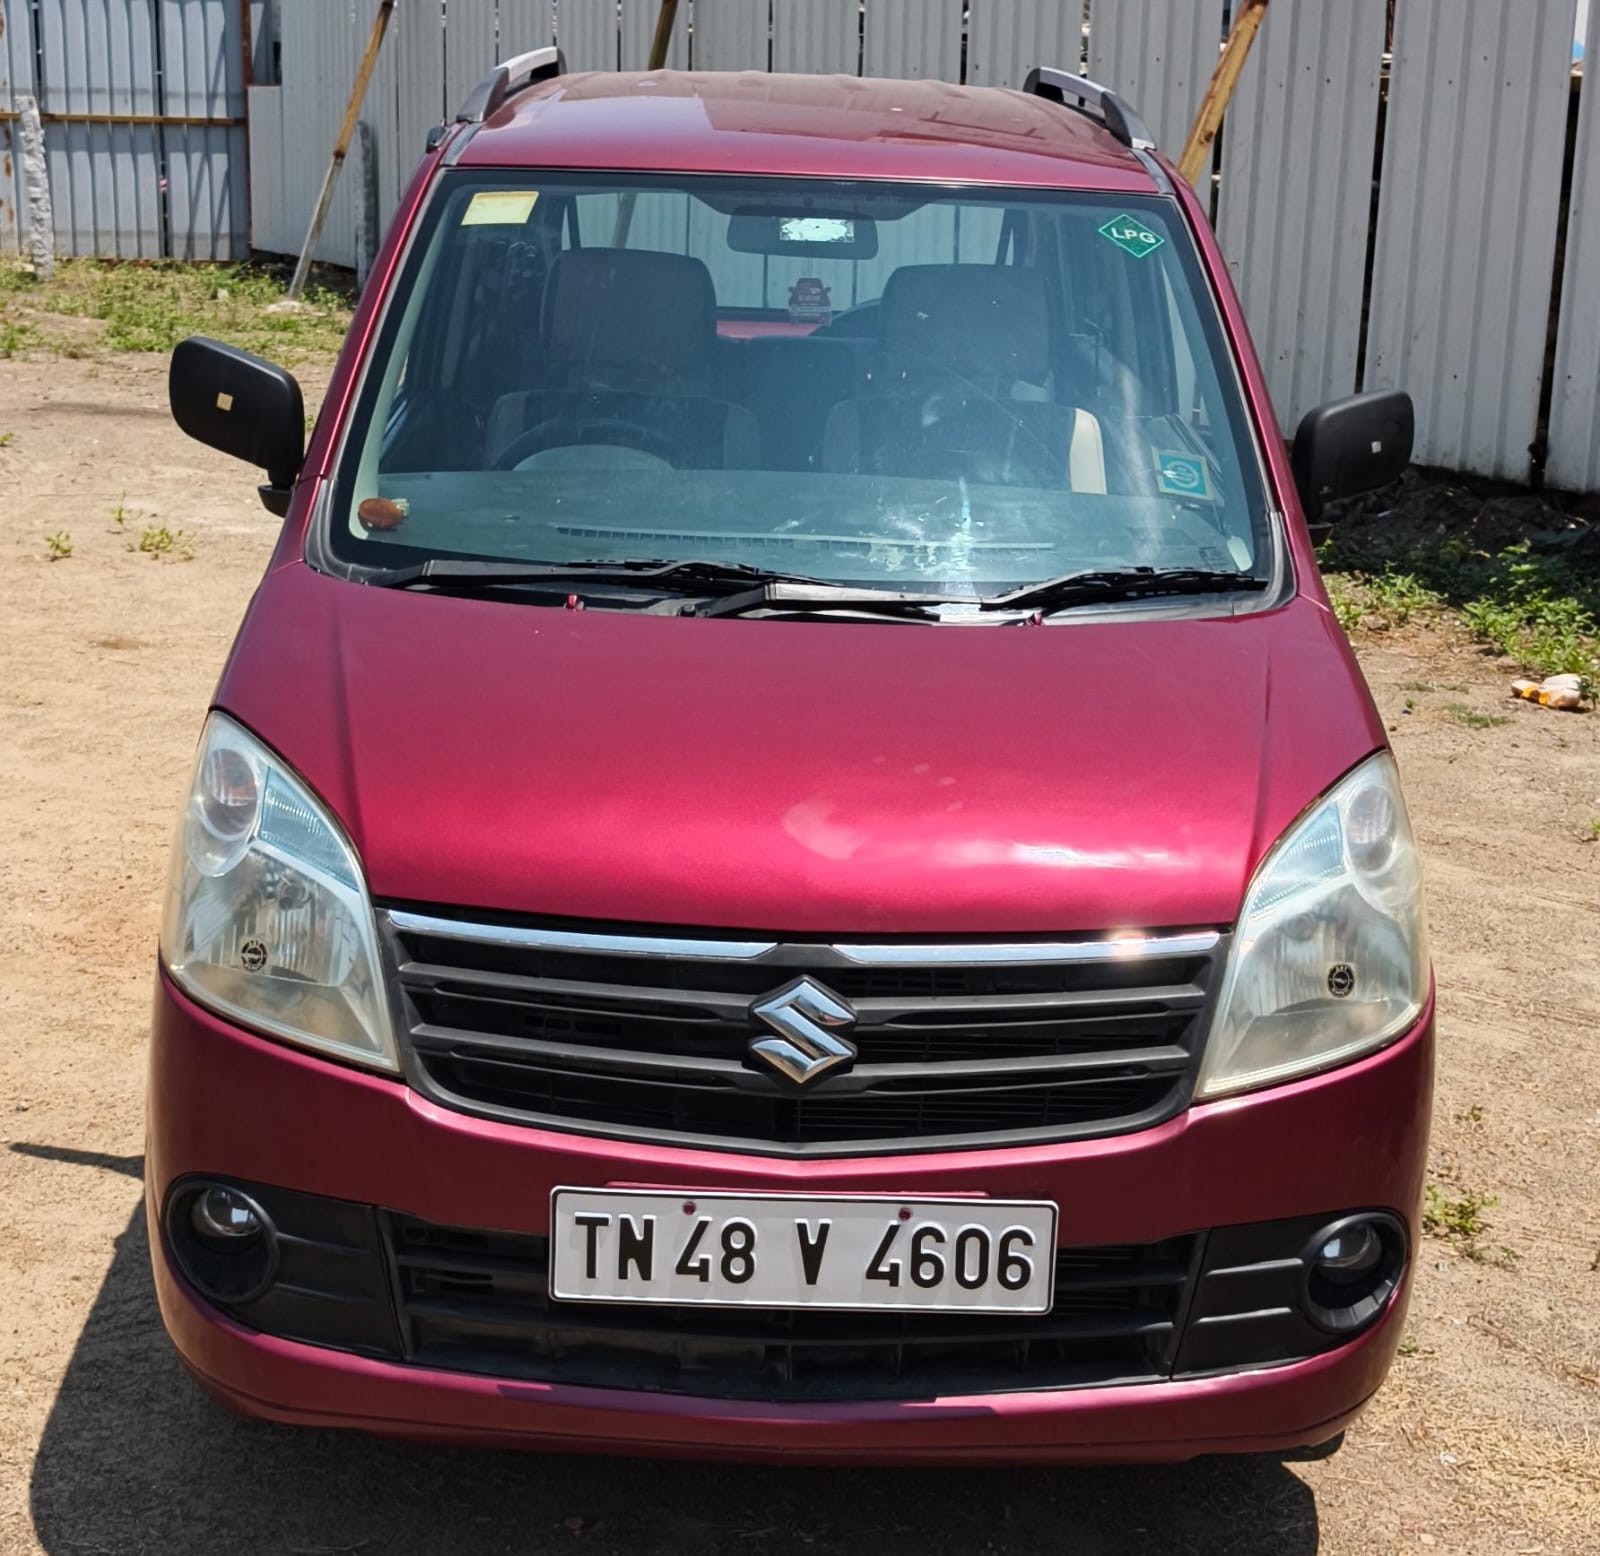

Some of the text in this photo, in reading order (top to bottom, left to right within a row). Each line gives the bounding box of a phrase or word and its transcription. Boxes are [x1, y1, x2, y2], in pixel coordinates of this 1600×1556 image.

[1111, 227, 1156, 244] LPG
[574, 1211, 1036, 1291] TN 48 V 4606
